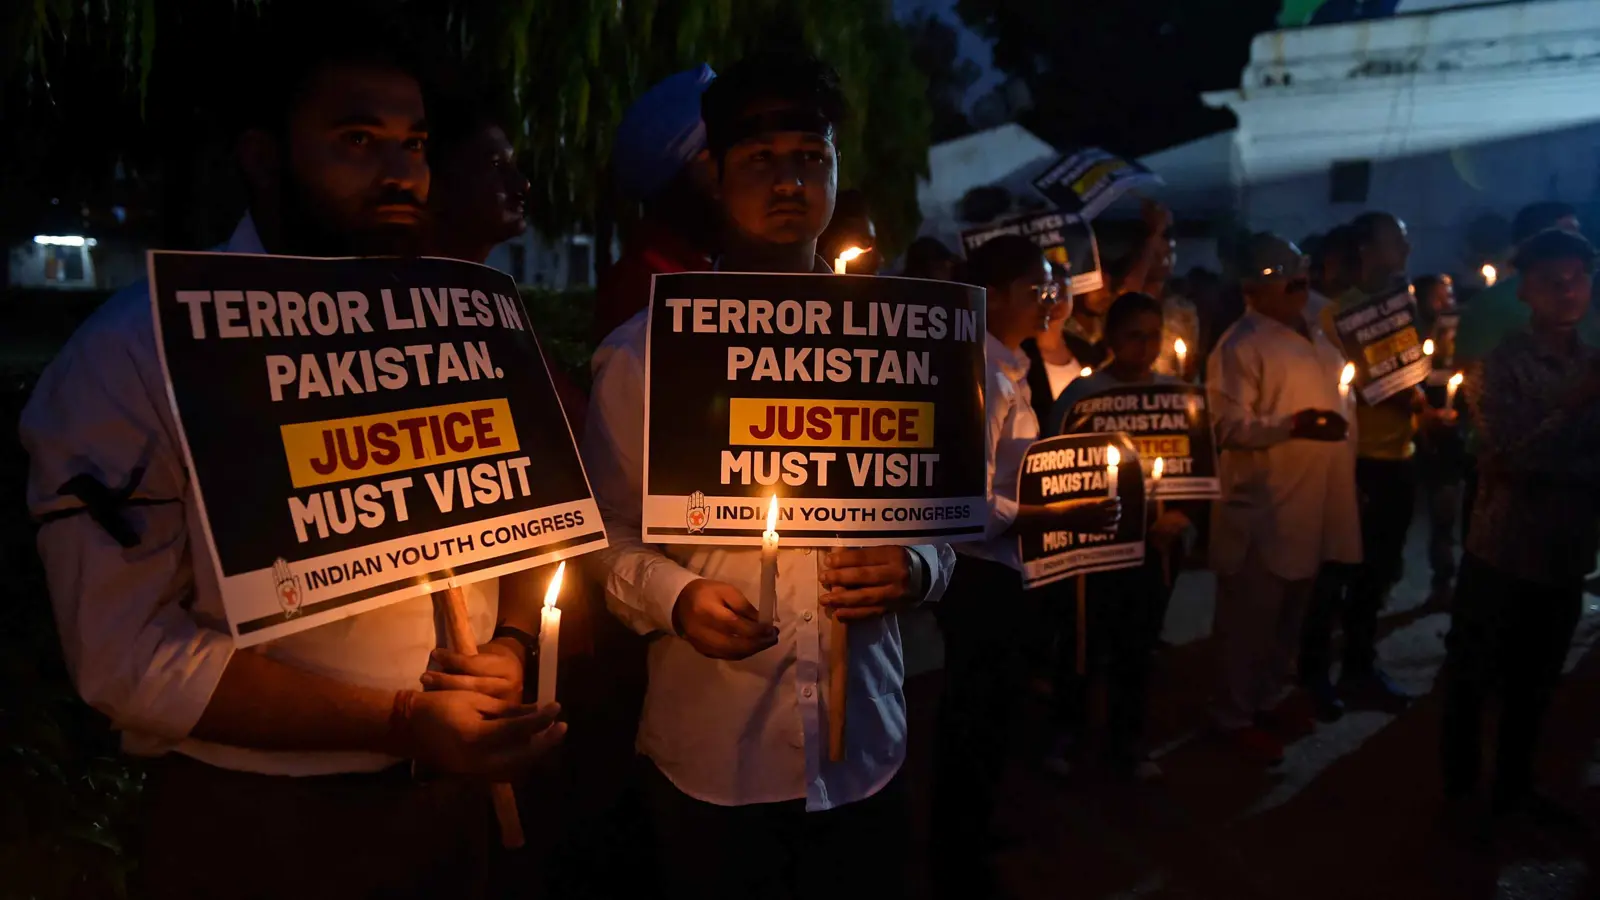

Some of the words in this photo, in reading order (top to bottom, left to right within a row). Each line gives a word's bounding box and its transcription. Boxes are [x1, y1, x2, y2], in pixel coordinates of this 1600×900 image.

[176, 289, 375, 340] TERROR
[380, 287, 494, 332] LIVES
[494, 293, 525, 332] IN
[664, 298, 832, 335] TERROR
[842, 301, 948, 340] LIVES
[954, 307, 977, 343] IN
[265, 340, 505, 402] PAKISTAN.
[726, 346, 939, 386] PAKISTAN.
[310, 408, 502, 476] JUSTICE
[748, 405, 919, 442] JUSTICE
[720, 449, 836, 488] MUST
[846, 451, 941, 488] VISIT
[1026, 448, 1076, 474] TERROR
[287, 477, 414, 544] MUST
[424, 456, 532, 515] VISIT
[716, 505, 794, 521] INDIN
[800, 507, 876, 522] YOUTH
[881, 505, 970, 522] CONGRESS
[305, 555, 383, 592] INDIAN
[389, 535, 475, 569] YOUTH
[480, 510, 586, 549] CONGRESS
